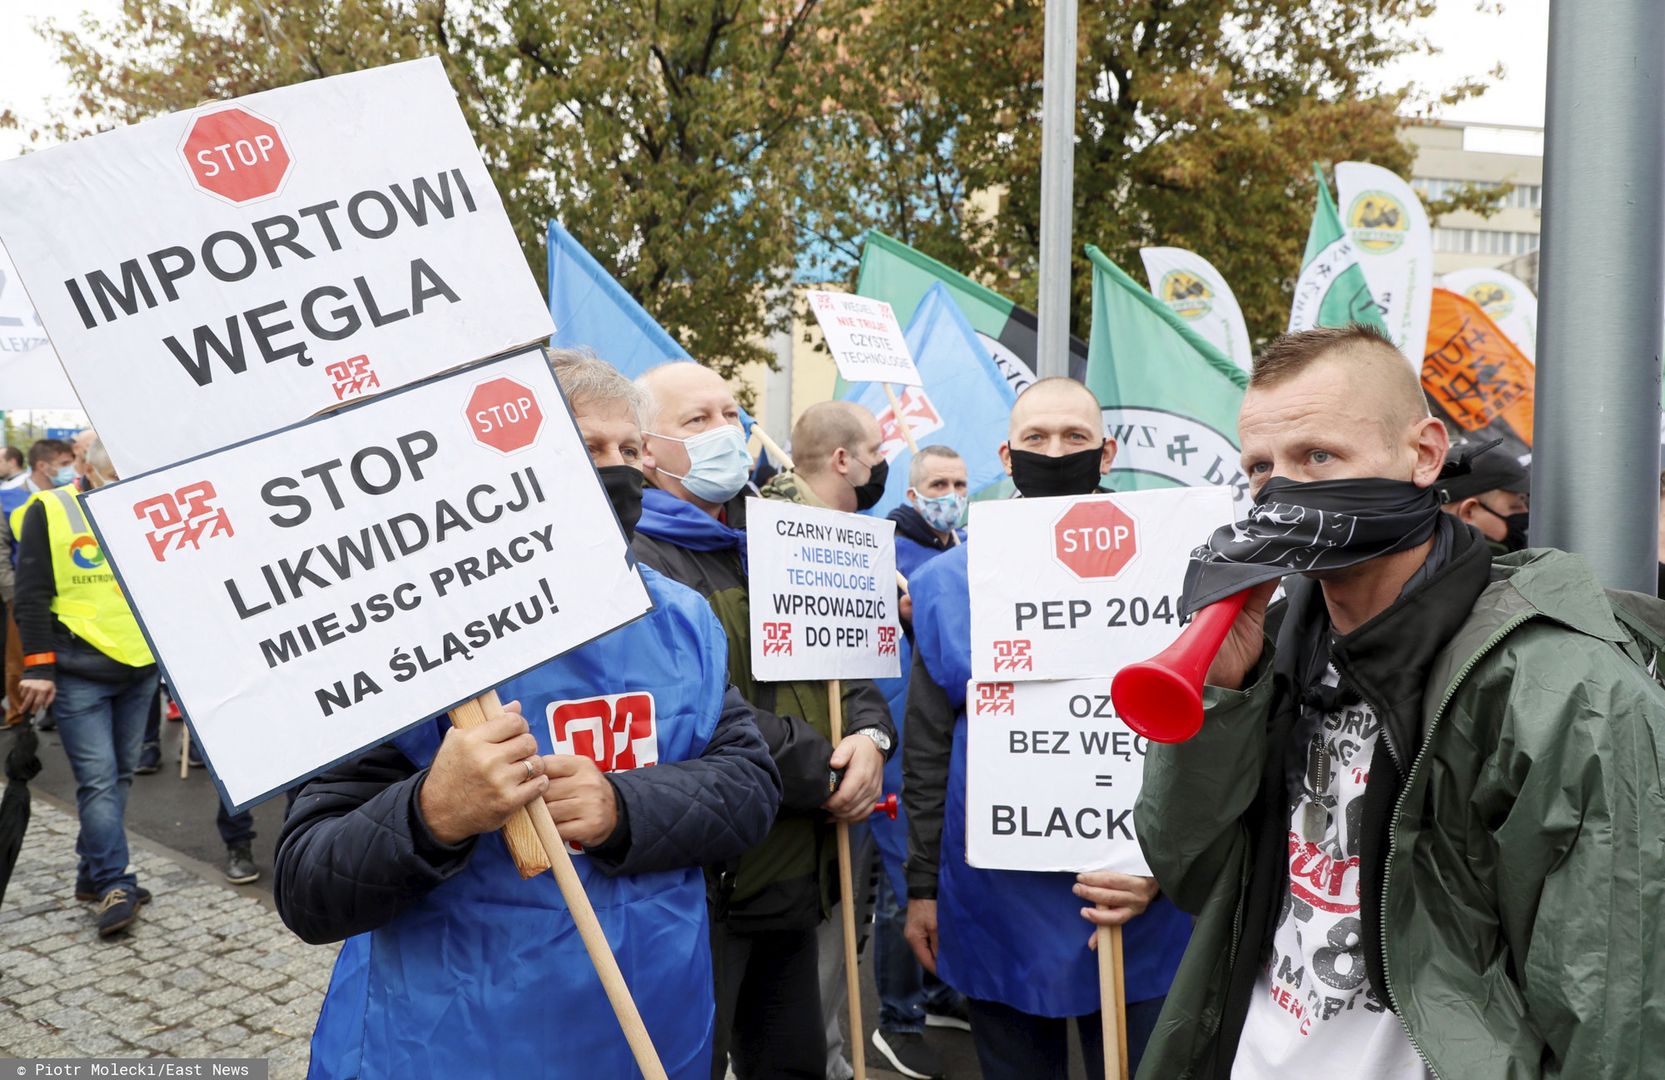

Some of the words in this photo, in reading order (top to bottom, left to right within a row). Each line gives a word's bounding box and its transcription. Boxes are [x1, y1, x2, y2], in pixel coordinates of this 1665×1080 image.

[197, 133, 275, 177] STOP
[65, 168, 477, 329] IMPORTOWI
[163, 258, 461, 387] WĘGLA
[850, 333, 893, 351] CZYSTE
[841, 352, 911, 369] TECHNOLOGIE
[475, 396, 533, 435] STOP
[260, 430, 438, 527] STOP
[223, 467, 546, 620] LIKWIDACJI
[776, 520, 832, 541] CZARNY
[836, 527, 879, 549] WĘGIEL
[1063, 525, 1129, 553] STOP
[802, 546, 870, 569] NIEBIESKIE
[787, 568, 876, 591] TECHNOLOGIE
[259, 582, 422, 668] MIEJSC
[429, 524, 556, 597] PRACY
[773, 593, 886, 619] WPROWADZIĆ
[1015, 600, 1091, 631] PEP
[314, 670, 383, 717] NA
[389, 578, 560, 682] ŚLĄSKU!
[806, 627, 831, 647] DO
[837, 628, 869, 648] PEP!
[1069, 695, 1121, 718] OZ
[1010, 731, 1070, 754] BEZ
[992, 805, 1135, 841] BLACK
